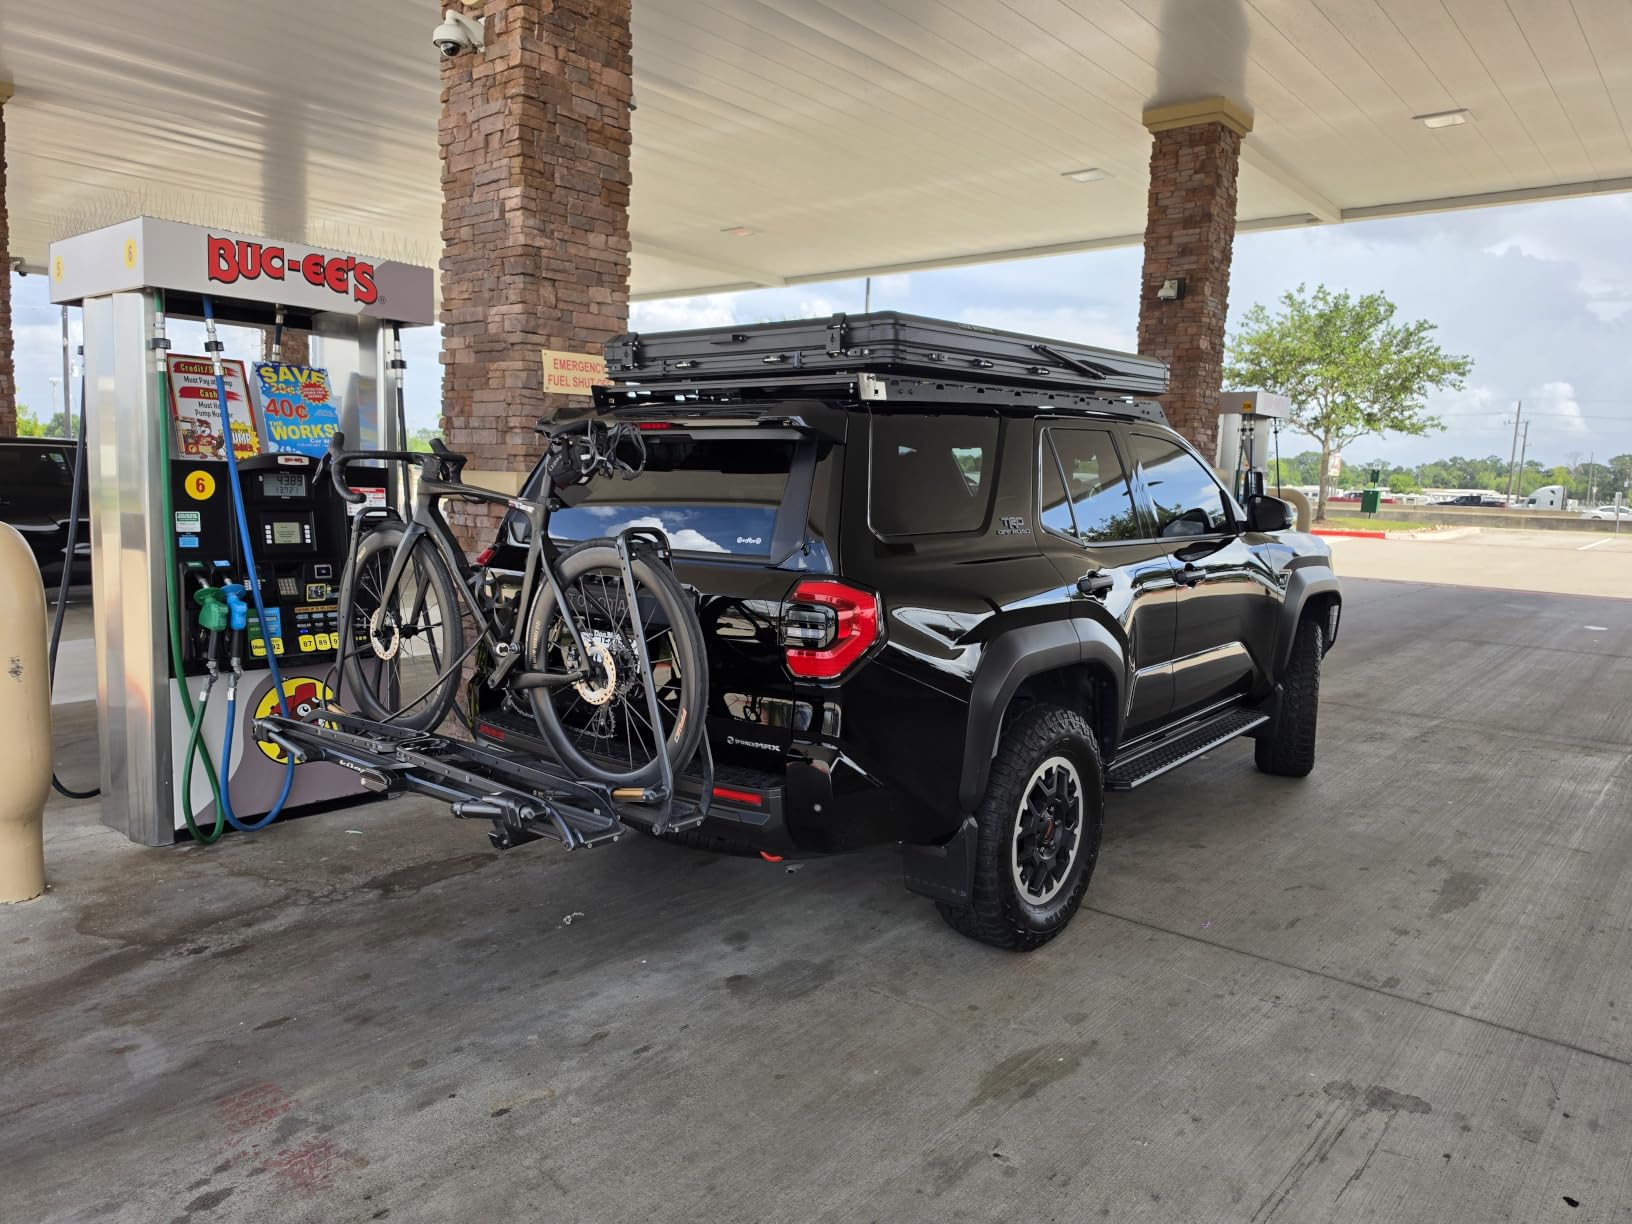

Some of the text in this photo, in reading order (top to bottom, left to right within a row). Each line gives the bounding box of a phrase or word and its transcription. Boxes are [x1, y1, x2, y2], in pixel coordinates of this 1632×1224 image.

[208, 233, 378, 305] BUC-EE'S
[553, 358, 604, 374] EMERGENCY
[183, 376, 198, 384] Must
[199, 377, 210, 386] Pay
[260, 367, 326, 384] SAVE
[547, 374, 571, 387] FUEL
[573, 376, 594, 388] SHUT
[199, 389, 218, 398] Cash
[195, 409, 211, 418] Pump
[271, 424, 338, 440] WORKS!
[196, 477, 205, 493] 6
[1001, 517, 1024, 529] TRD
[569, 593, 626, 613] TOOTA
